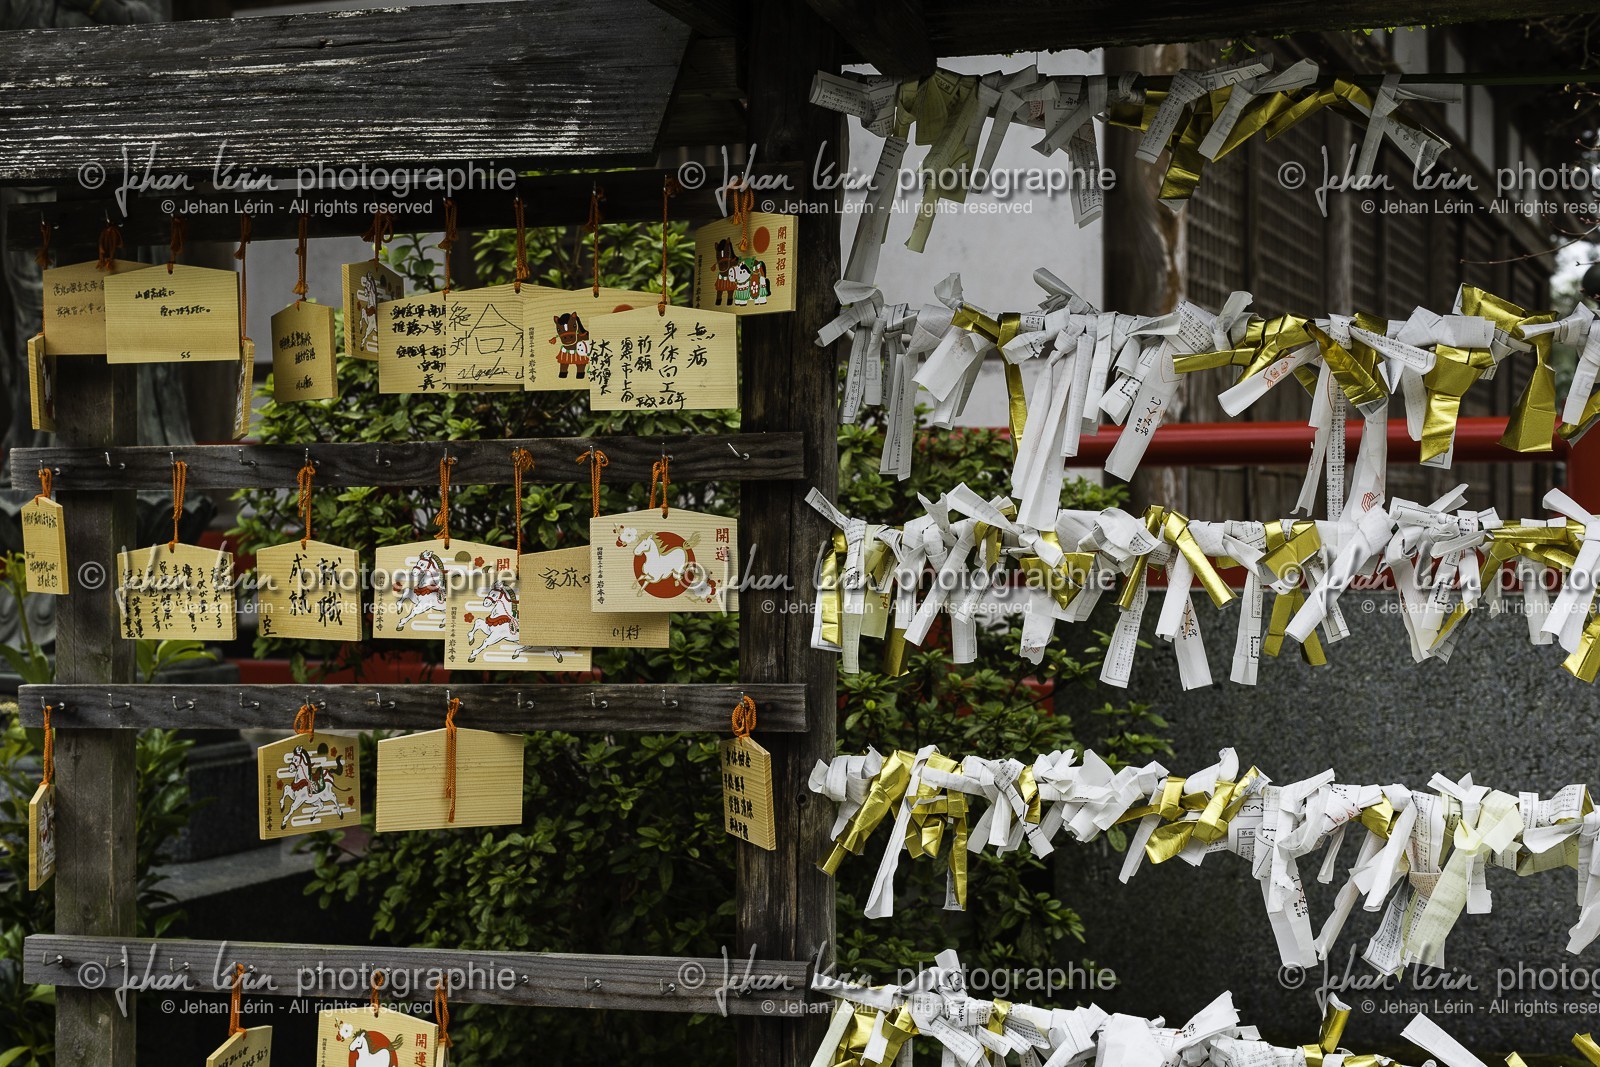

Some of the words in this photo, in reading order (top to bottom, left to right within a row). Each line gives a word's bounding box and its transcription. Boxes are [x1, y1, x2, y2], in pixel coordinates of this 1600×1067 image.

[775, 226, 787, 287] 開運招福
[715, 528, 730, 562] 開運
